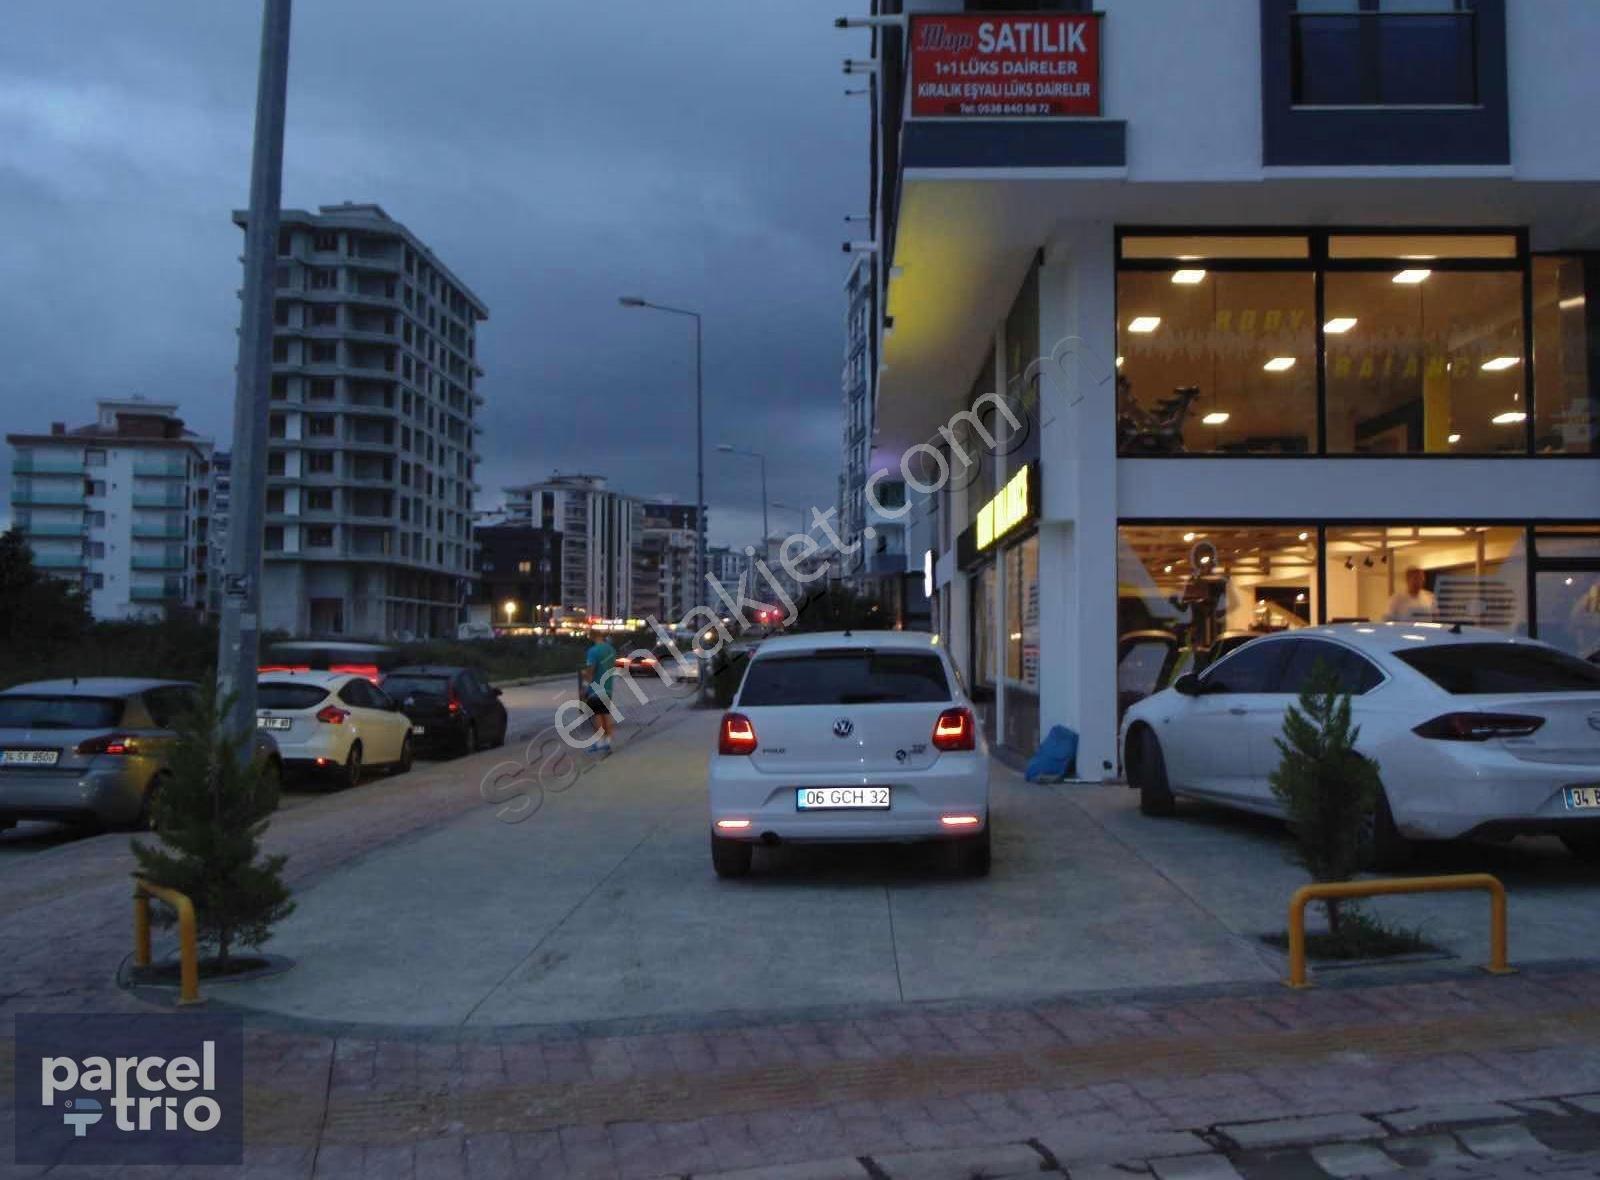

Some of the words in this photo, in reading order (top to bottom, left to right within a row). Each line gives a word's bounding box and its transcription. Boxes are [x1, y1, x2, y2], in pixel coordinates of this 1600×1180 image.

[977, 22, 1087, 52] SATILIK
[935, 62, 957, 75] 1+1
[960, 58, 999, 75] LÜKS
[1002, 58, 1078, 75] DAİRELER
[1004, 80, 1033, 97] LÜKS
[1035, 82, 1090, 97] DAİRELER
[806, 791, 825, 805] 06
[830, 790, 864, 804] GCH
[870, 790, 888, 804] 32
[1574, 790, 1589, 806] 34
